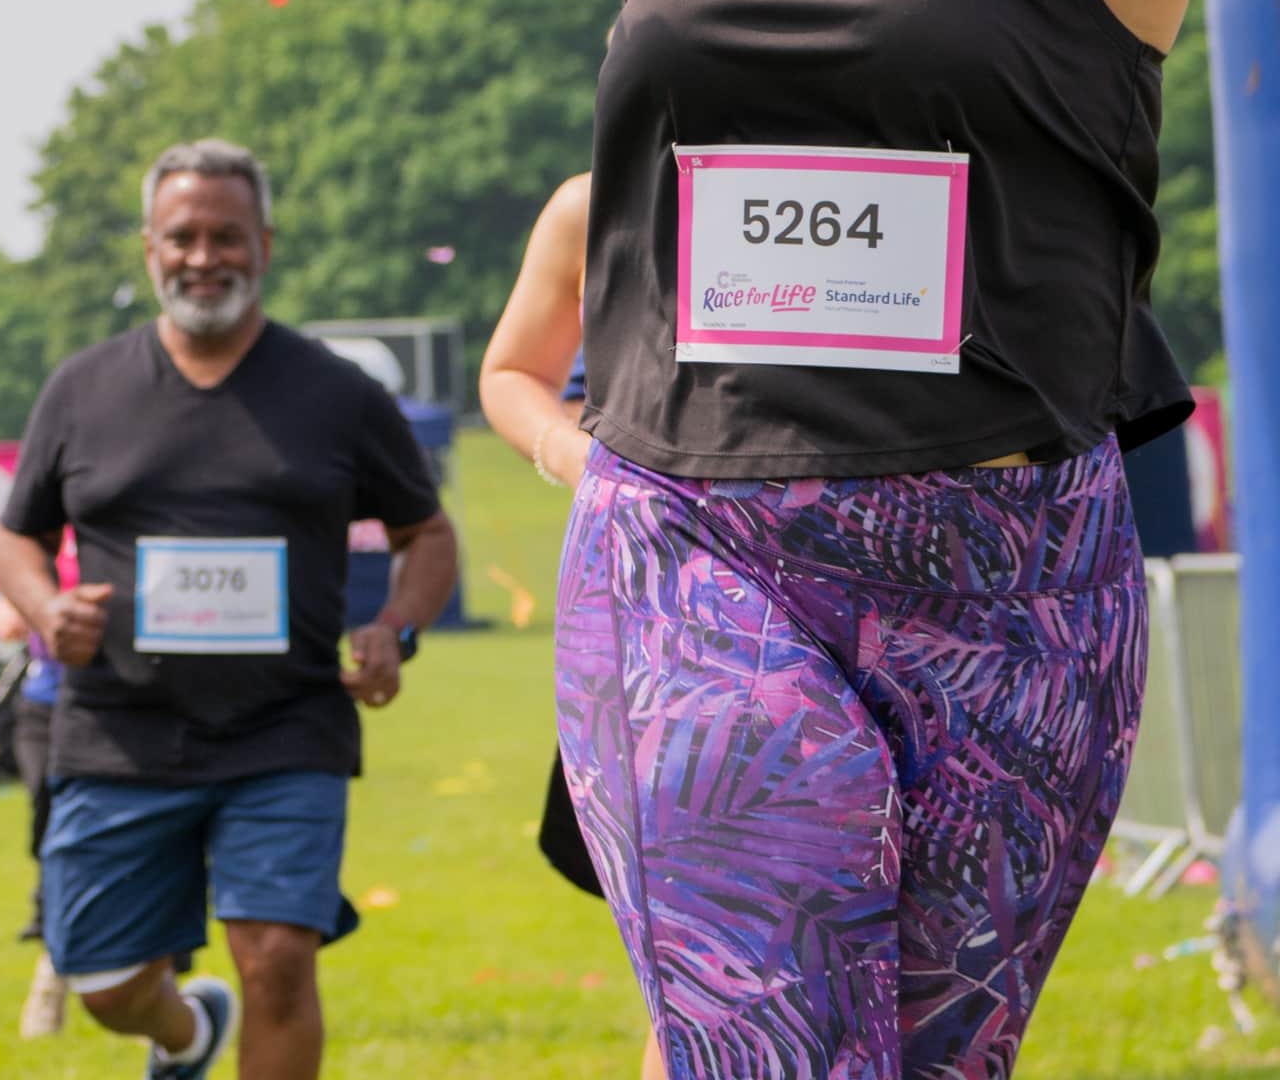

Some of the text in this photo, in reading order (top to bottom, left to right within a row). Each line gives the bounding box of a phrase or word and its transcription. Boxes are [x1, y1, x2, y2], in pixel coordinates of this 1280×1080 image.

[743, 199, 883, 249] 5264
[703, 283, 817, 312] Race for Life
[825, 289, 921, 307] Standard Life
[176, 567, 248, 593] 3076
